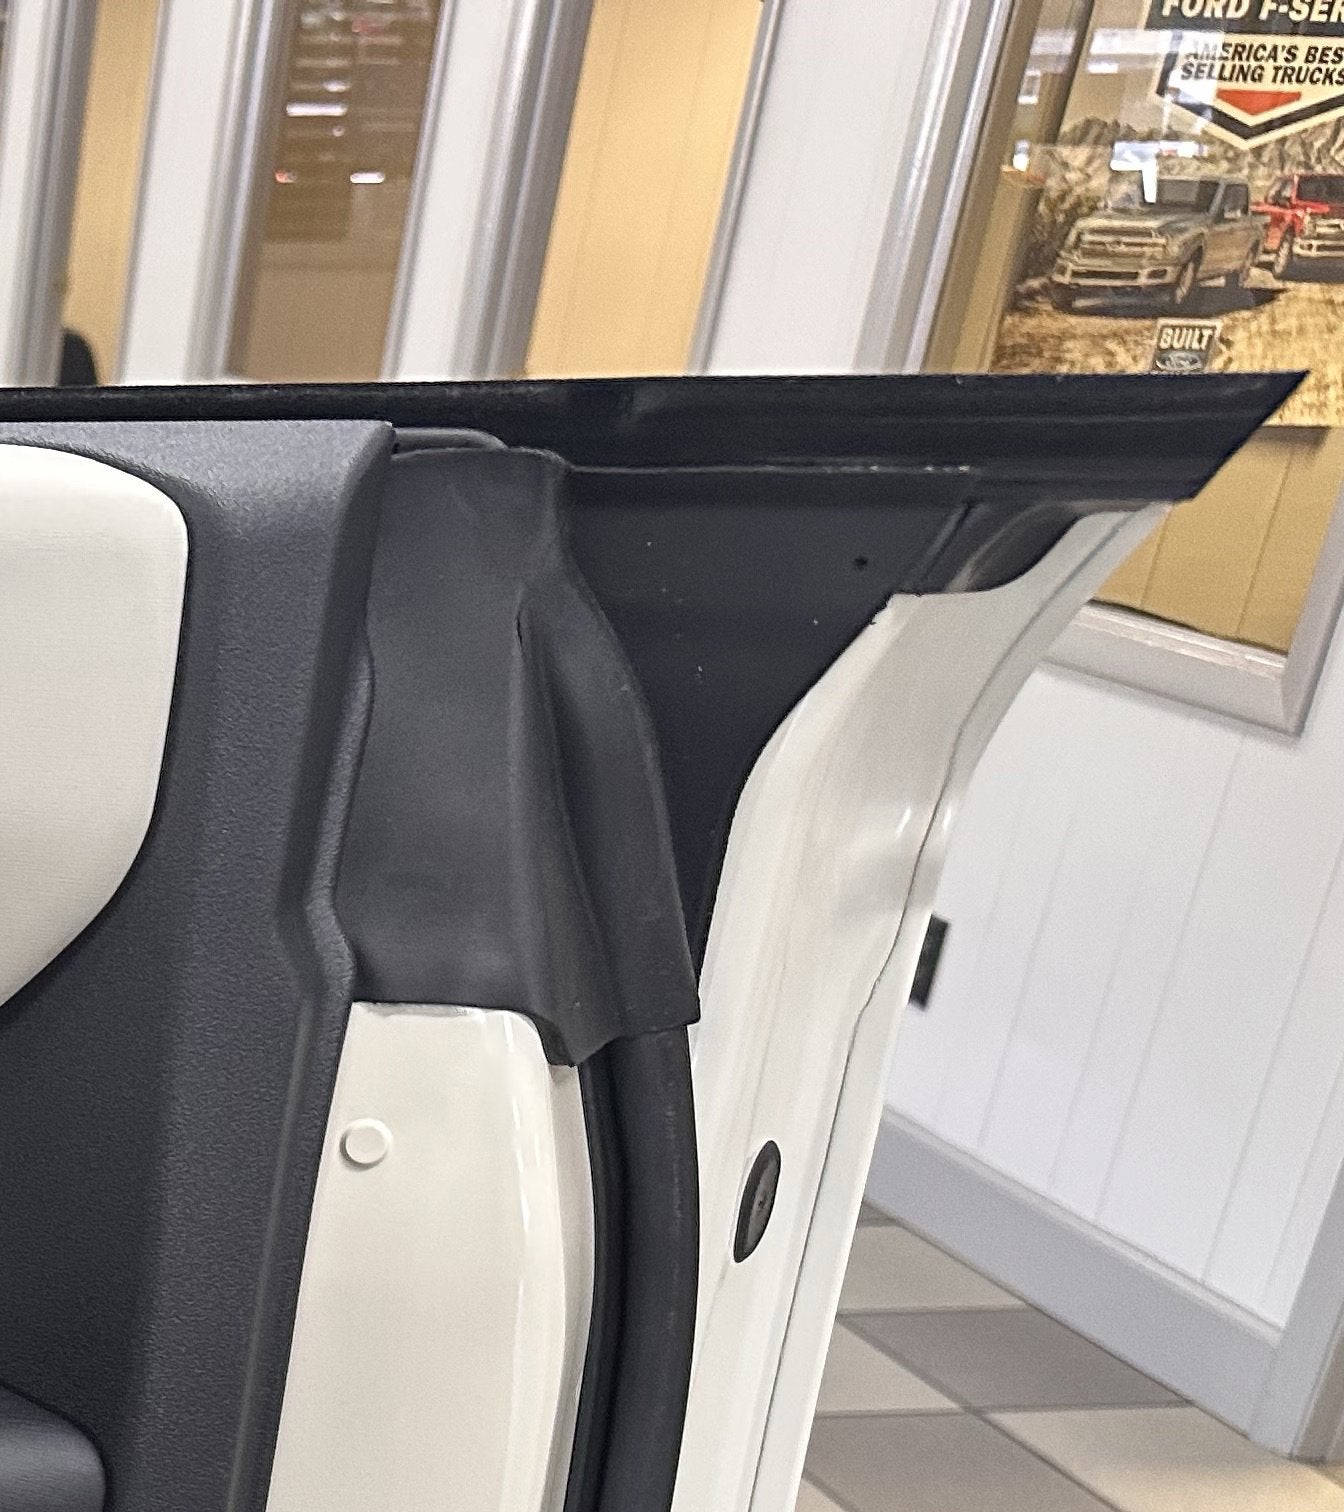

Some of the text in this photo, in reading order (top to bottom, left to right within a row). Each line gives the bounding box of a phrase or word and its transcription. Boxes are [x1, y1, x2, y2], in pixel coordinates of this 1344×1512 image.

[1161, 0, 1250, 18] FORD
[1181, 62, 1265, 83] SELLING
[1160, 327, 1213, 350] BUILT
